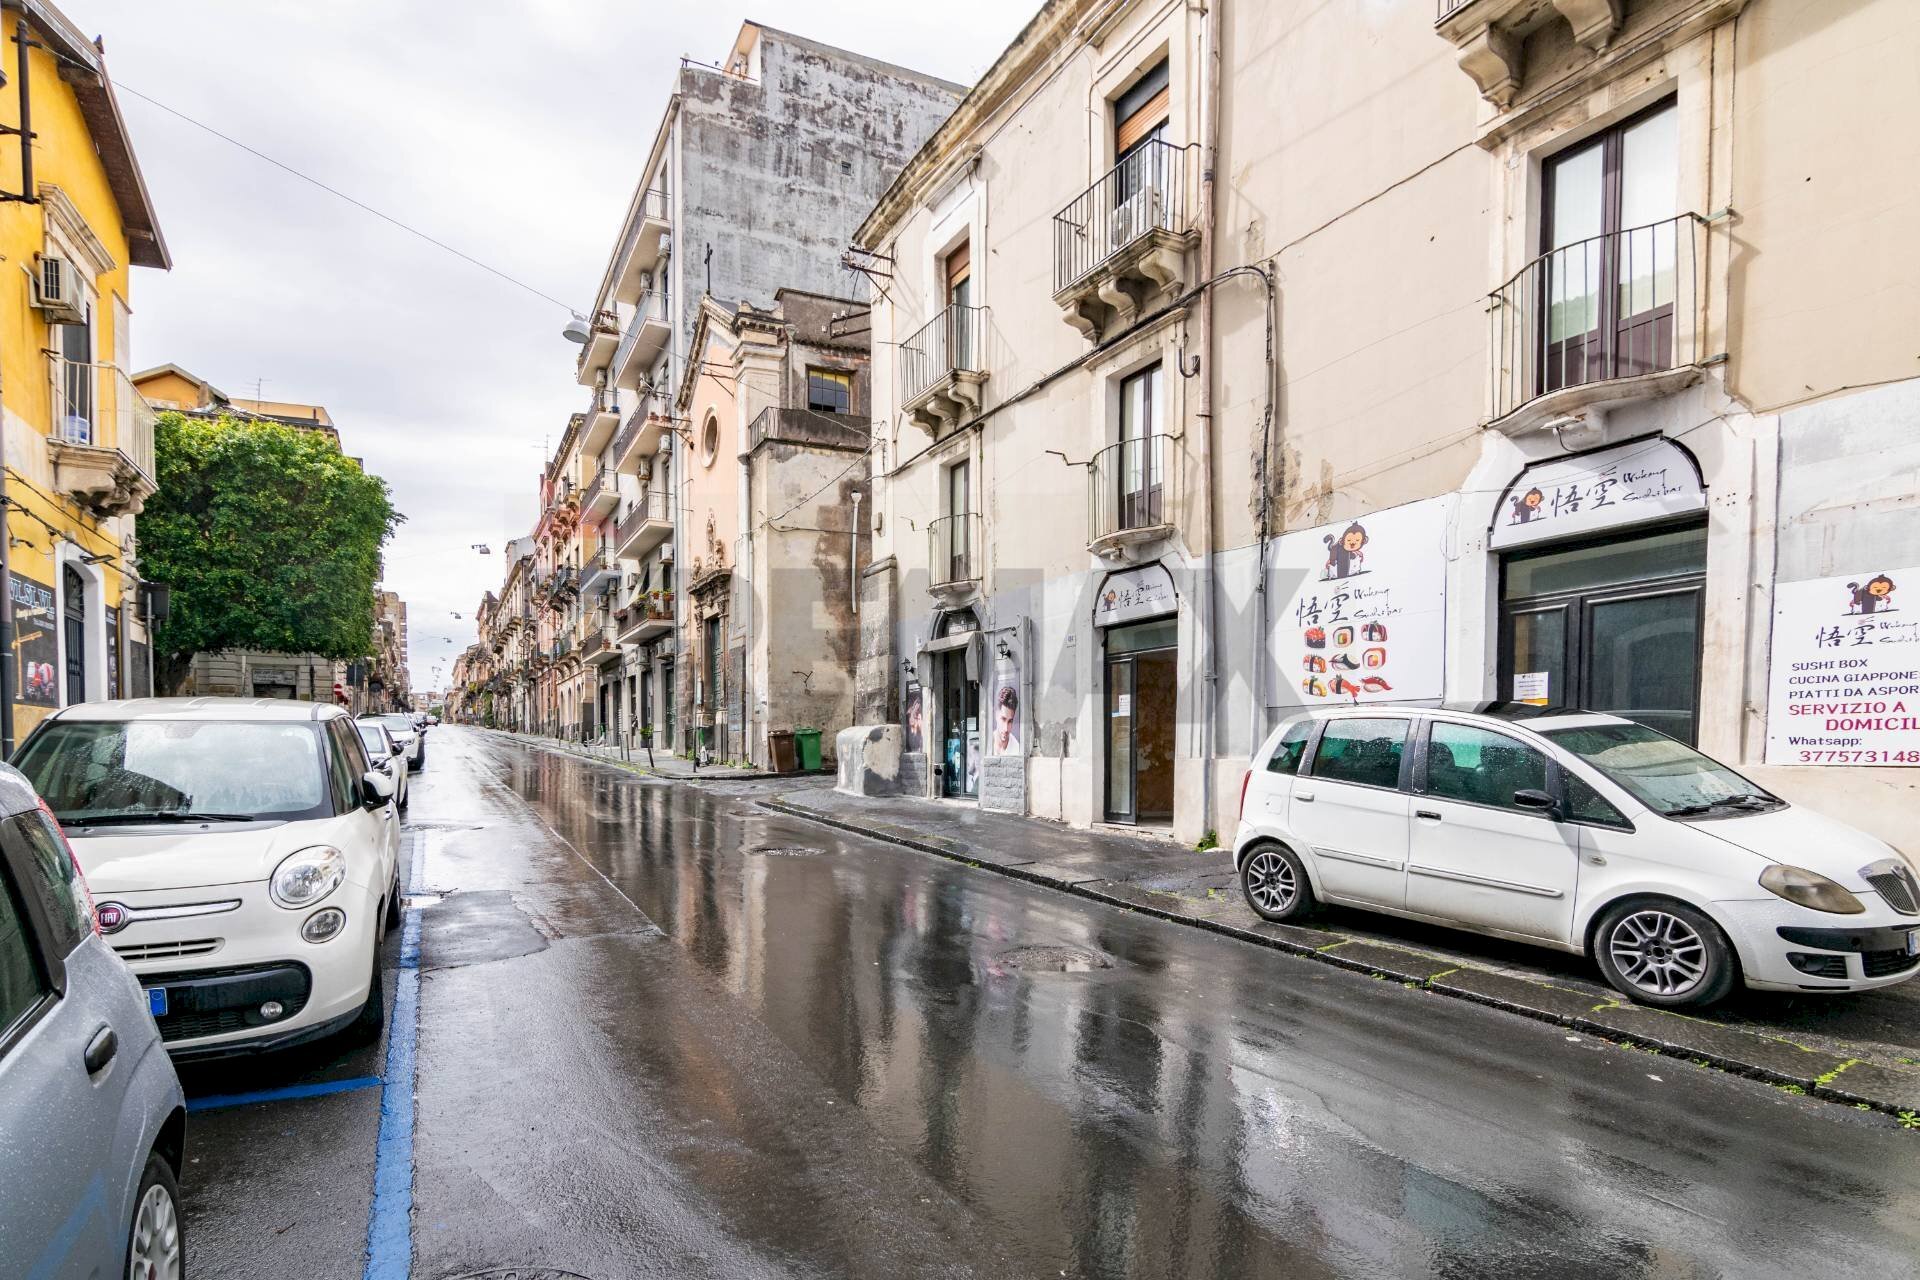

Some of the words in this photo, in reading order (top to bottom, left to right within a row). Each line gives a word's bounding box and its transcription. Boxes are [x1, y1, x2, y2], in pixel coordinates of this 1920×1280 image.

[1791, 661, 1835, 671] SUSHI
[1839, 659, 1868, 669] BOX
[1789, 675, 1840, 685] CUCINA
[1789, 688, 1839, 699] PIATTI
[1844, 688, 1863, 697] DA
[1789, 702, 1886, 715] SERVIZIO
[1892, 701, 1906, 712] A
[1825, 717, 1920, 731] DOMICIL
[1788, 736, 1862, 747] Whatsapp:
[1799, 750, 1920, 763] 377573148
[100, 912, 118, 924] FIAT
